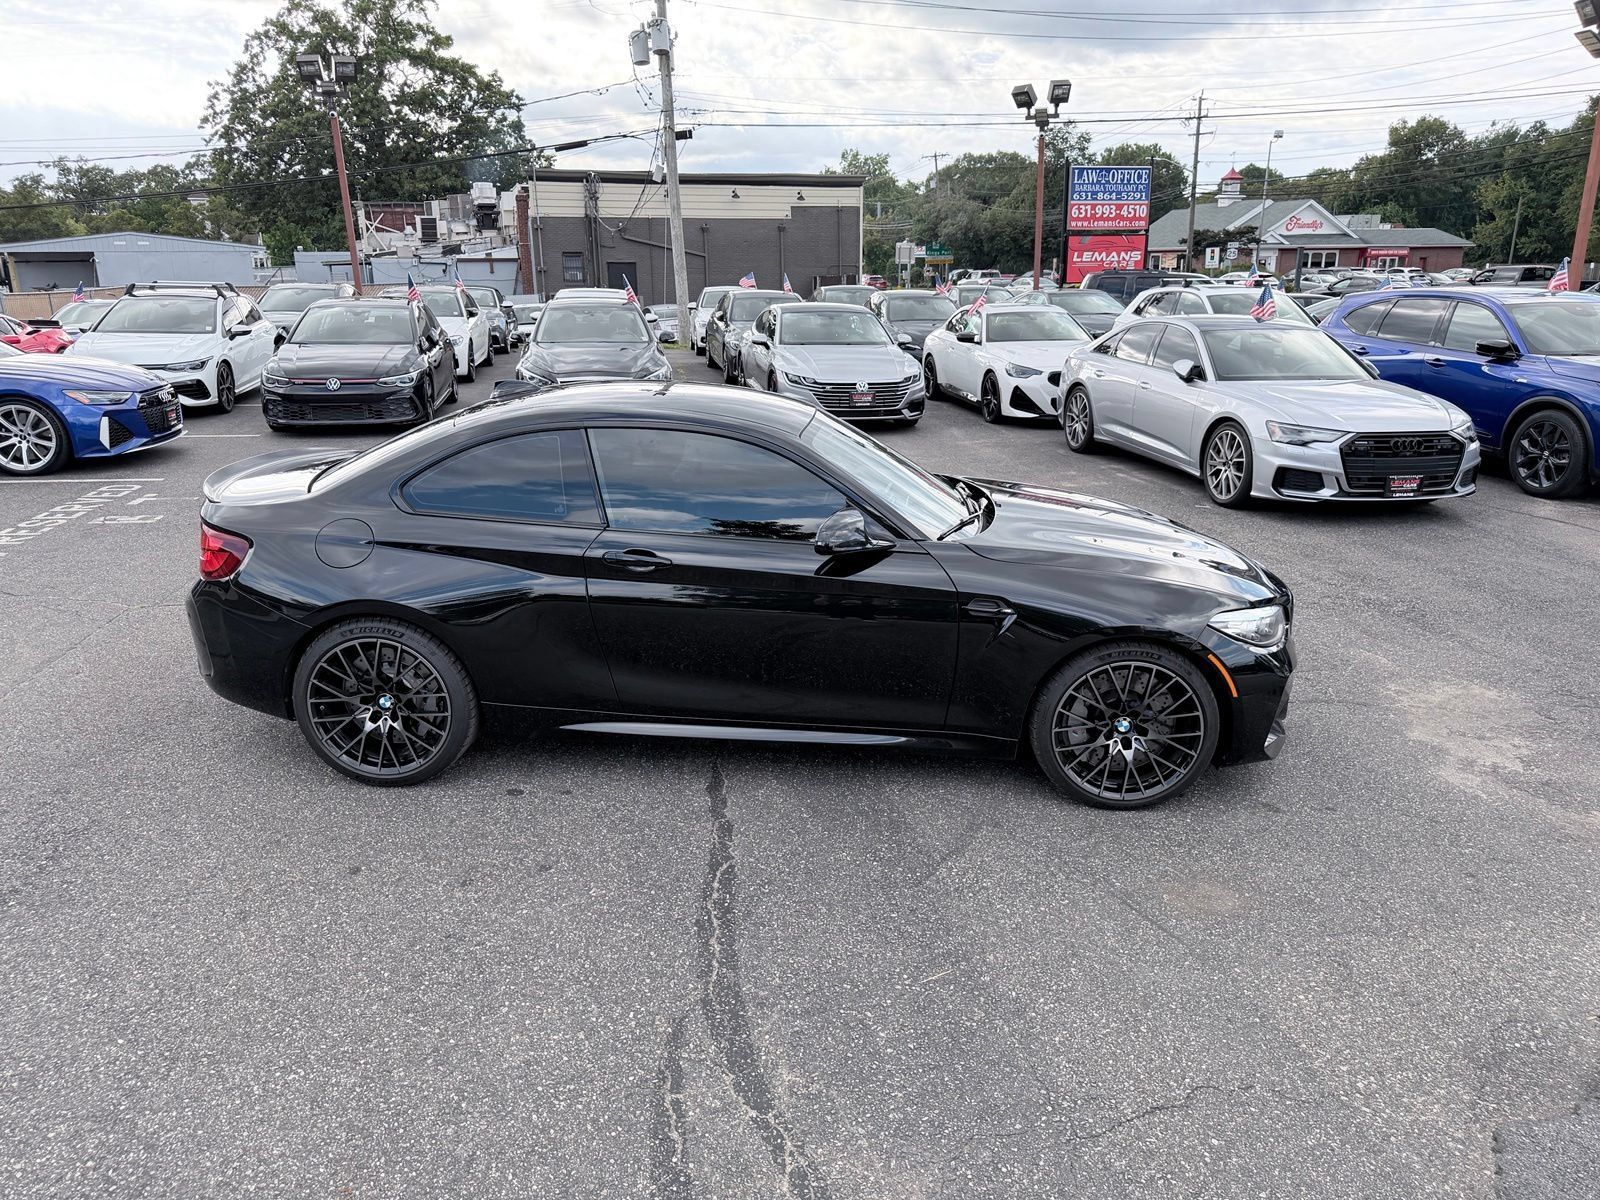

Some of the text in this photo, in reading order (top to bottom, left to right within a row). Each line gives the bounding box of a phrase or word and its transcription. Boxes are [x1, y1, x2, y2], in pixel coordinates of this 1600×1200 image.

[1073, 169, 1149, 183] LAW OFFICE
[1075, 184, 1147, 192] BARBARA TOUHAMY PC
[1073, 192, 1146, 200] 631-864-5291
[1071, 205, 1147, 218] 631-993-4510
[1070, 219, 1146, 227] www.LemansCars.com
[1286, 215, 1324, 232] Friendly's
[1073, 251, 1141, 262] LEMANS
[1227, 250, 1237, 258] 25
[352, 627, 403, 637] MICHELIN
